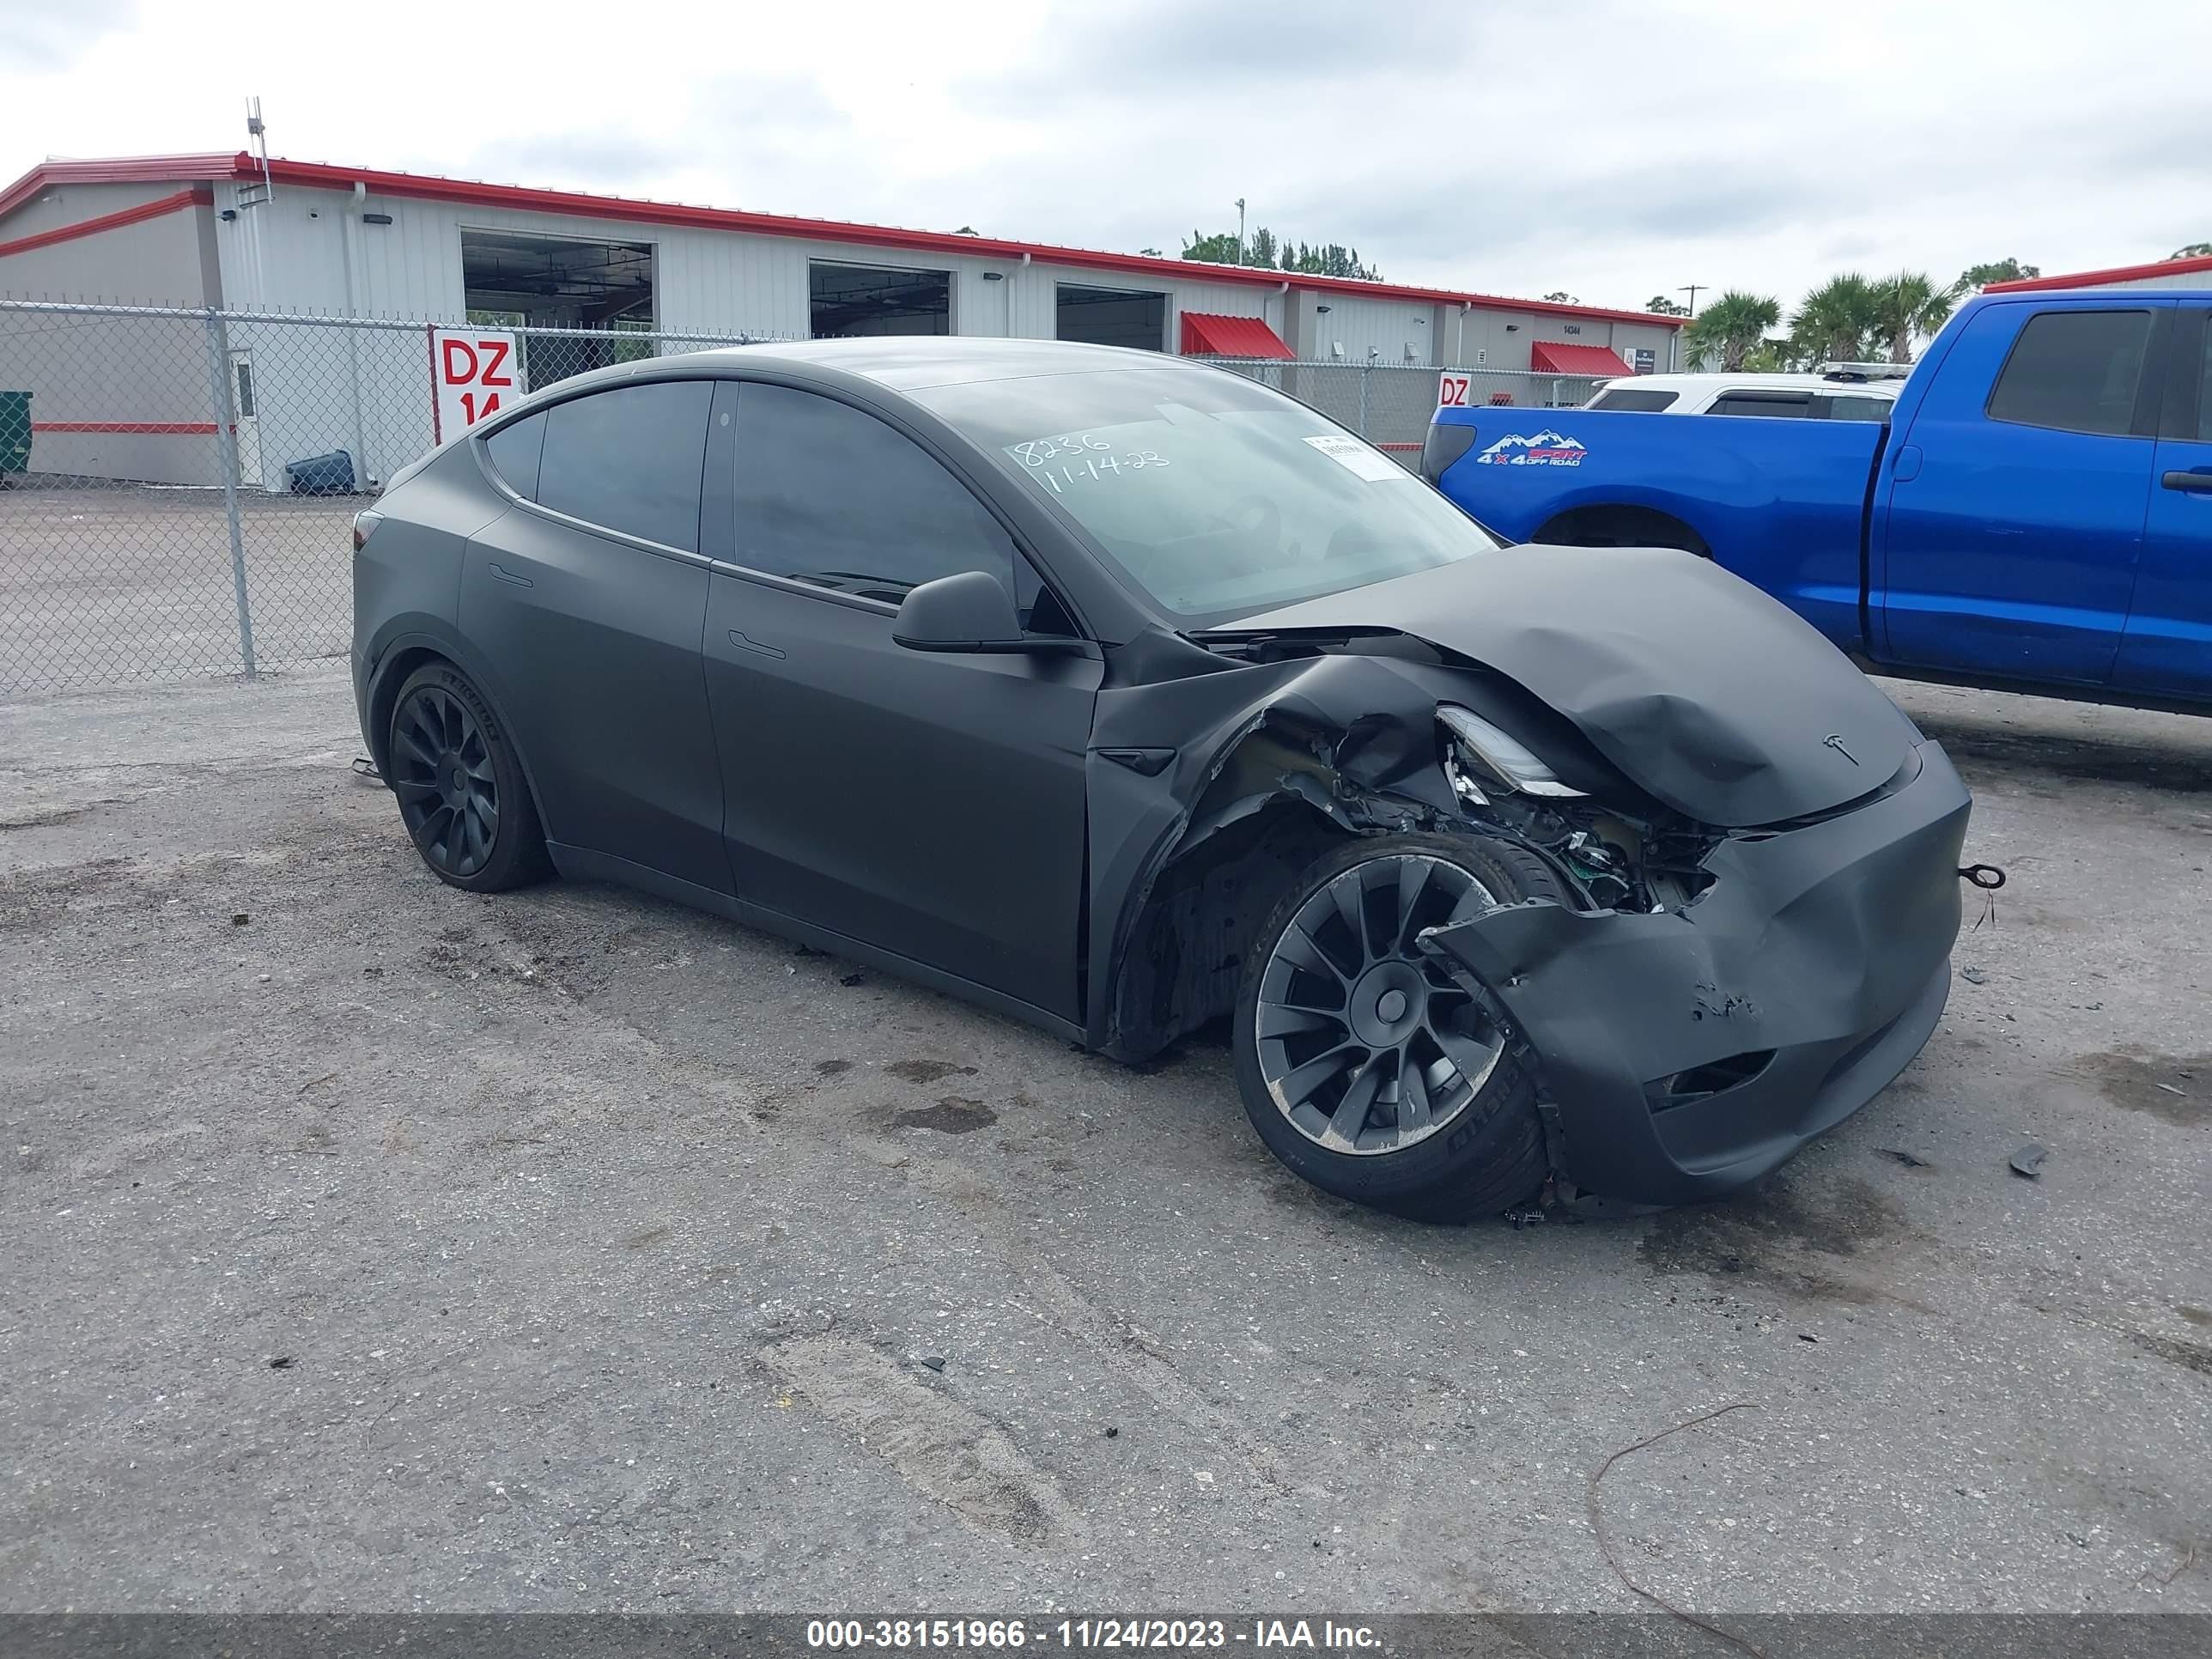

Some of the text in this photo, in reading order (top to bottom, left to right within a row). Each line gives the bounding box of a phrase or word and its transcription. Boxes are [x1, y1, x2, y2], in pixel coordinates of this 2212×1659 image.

[442, 339, 512, 386] DZ
[1442, 378, 1468, 405] DZ
[1014, 434, 1110, 467] 8236
[1528, 448, 1587, 460] SPORT
